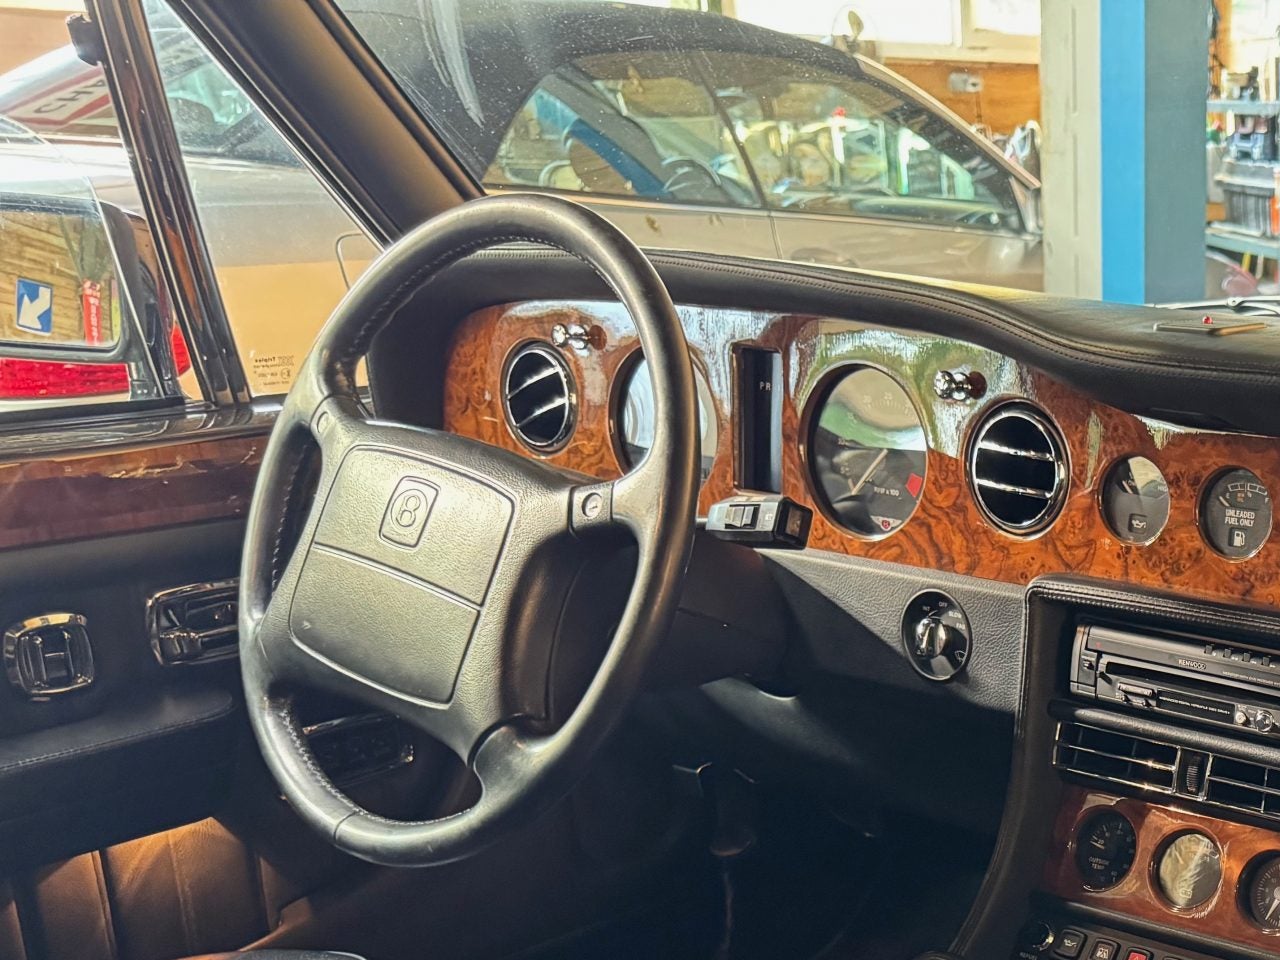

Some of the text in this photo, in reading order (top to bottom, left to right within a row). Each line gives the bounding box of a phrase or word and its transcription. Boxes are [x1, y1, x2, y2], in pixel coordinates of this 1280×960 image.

[1225, 508, 1255, 519] UNLEADED
[1225, 516, 1255, 527] FUEL ONLY
[1178, 659, 1207, 670] KENWOOD
